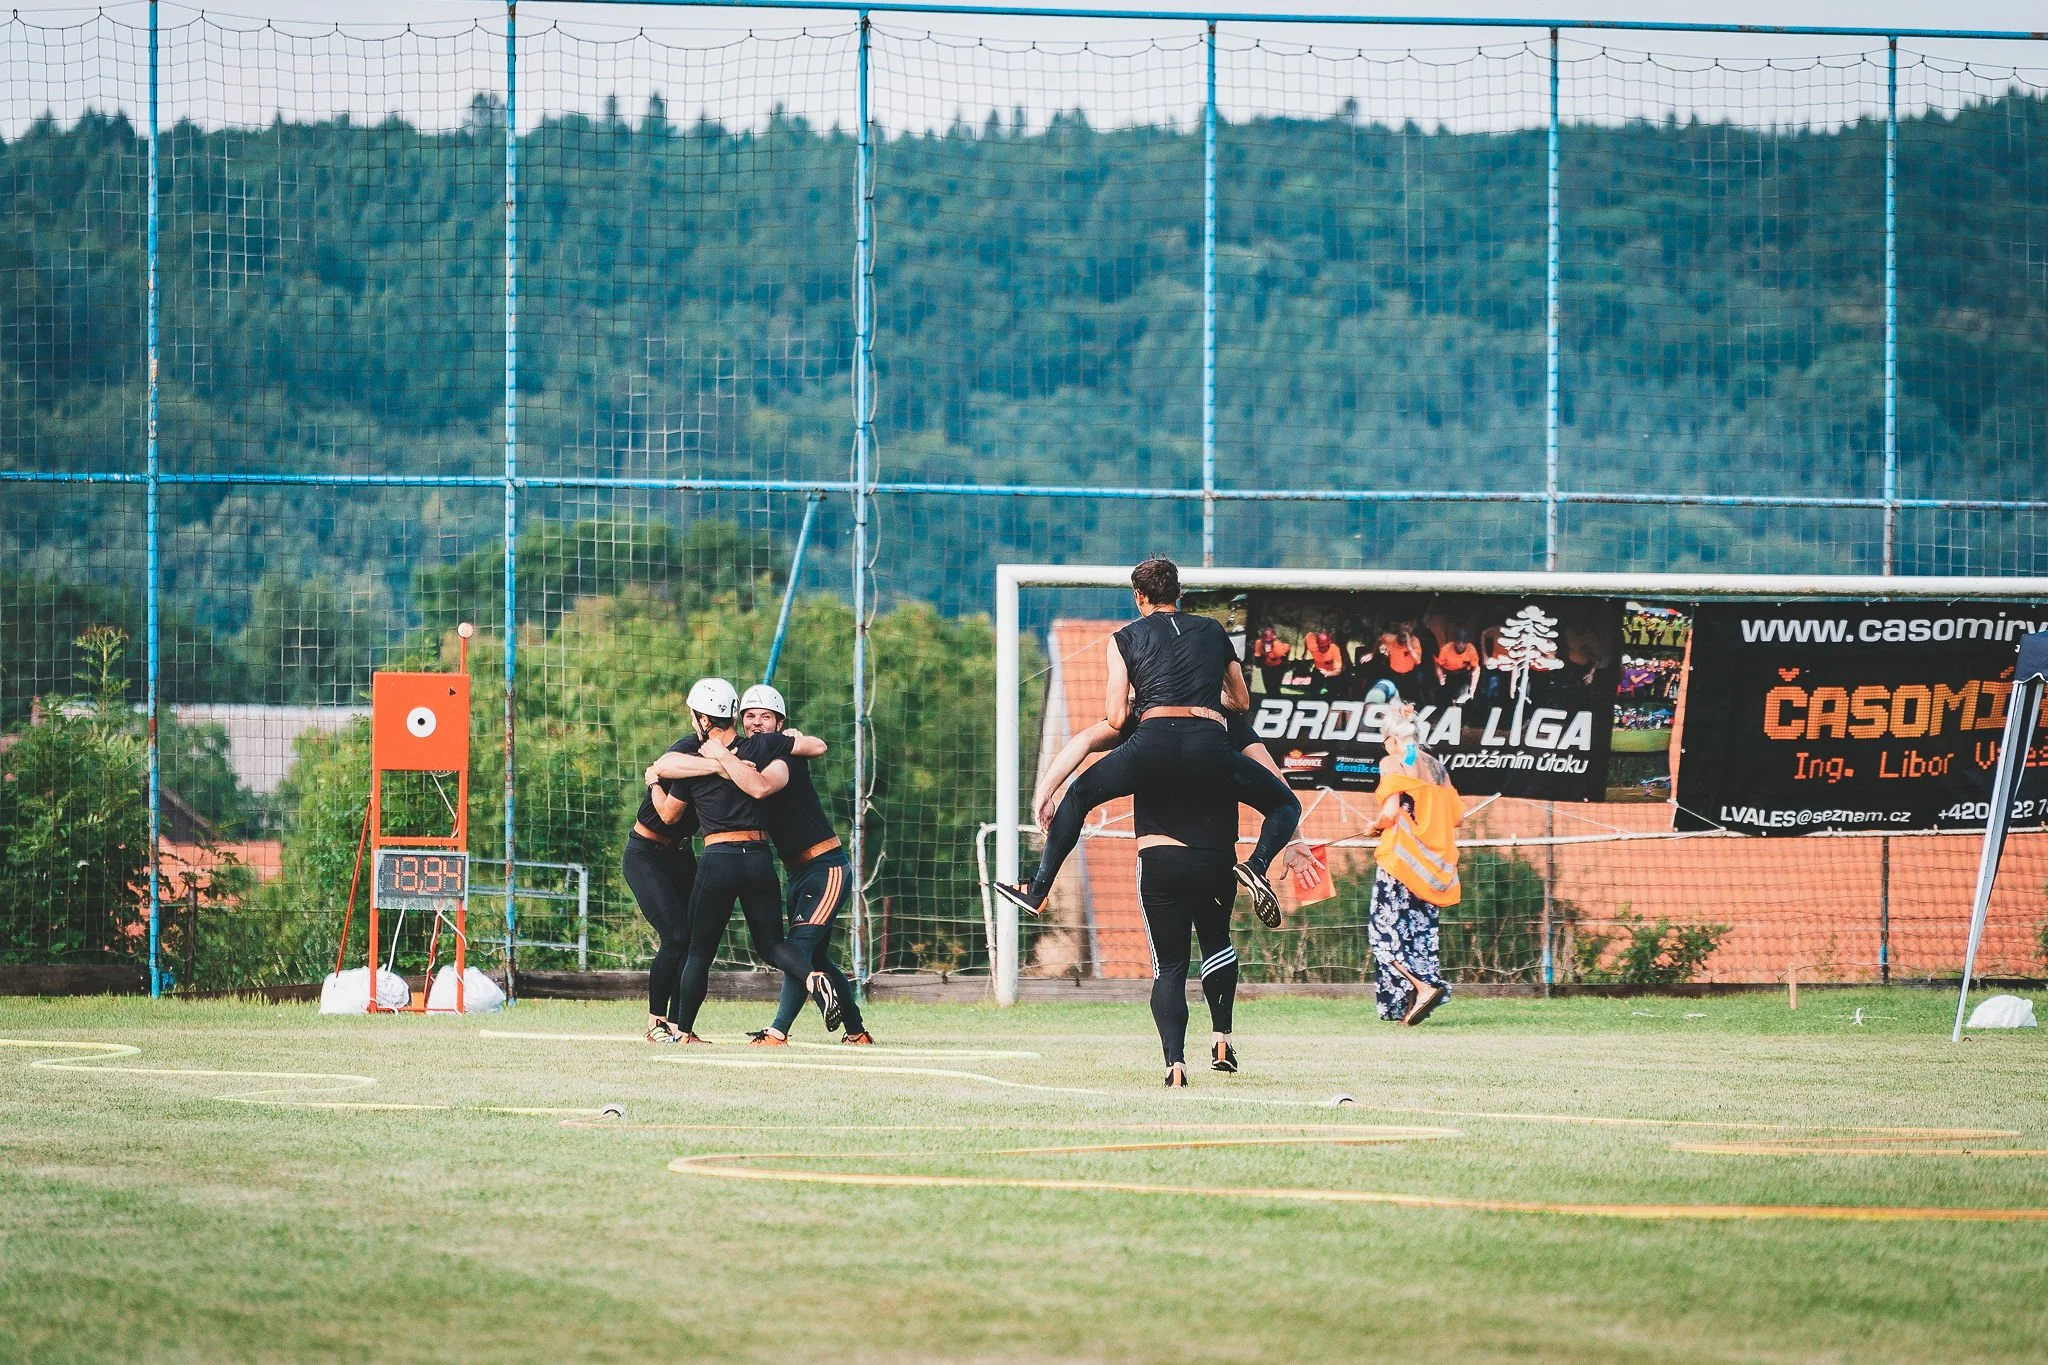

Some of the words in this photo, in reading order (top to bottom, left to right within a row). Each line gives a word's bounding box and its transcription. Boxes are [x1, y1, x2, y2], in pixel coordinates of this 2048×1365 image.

[1764, 667, 2048, 740] ČASOMÍ
[1480, 706, 1592, 751] LIGA
[1450, 750, 1534, 770] požárním
[1536, 752, 1588, 774] útoku
[1794, 752, 1854, 783] Ing.
[1879, 750, 1954, 778] Libor
[1720, 805, 1911, 828] LVALES@seznam.cz
[1938, 801, 1990, 820] +420
[2010, 800, 2034, 819] 22
